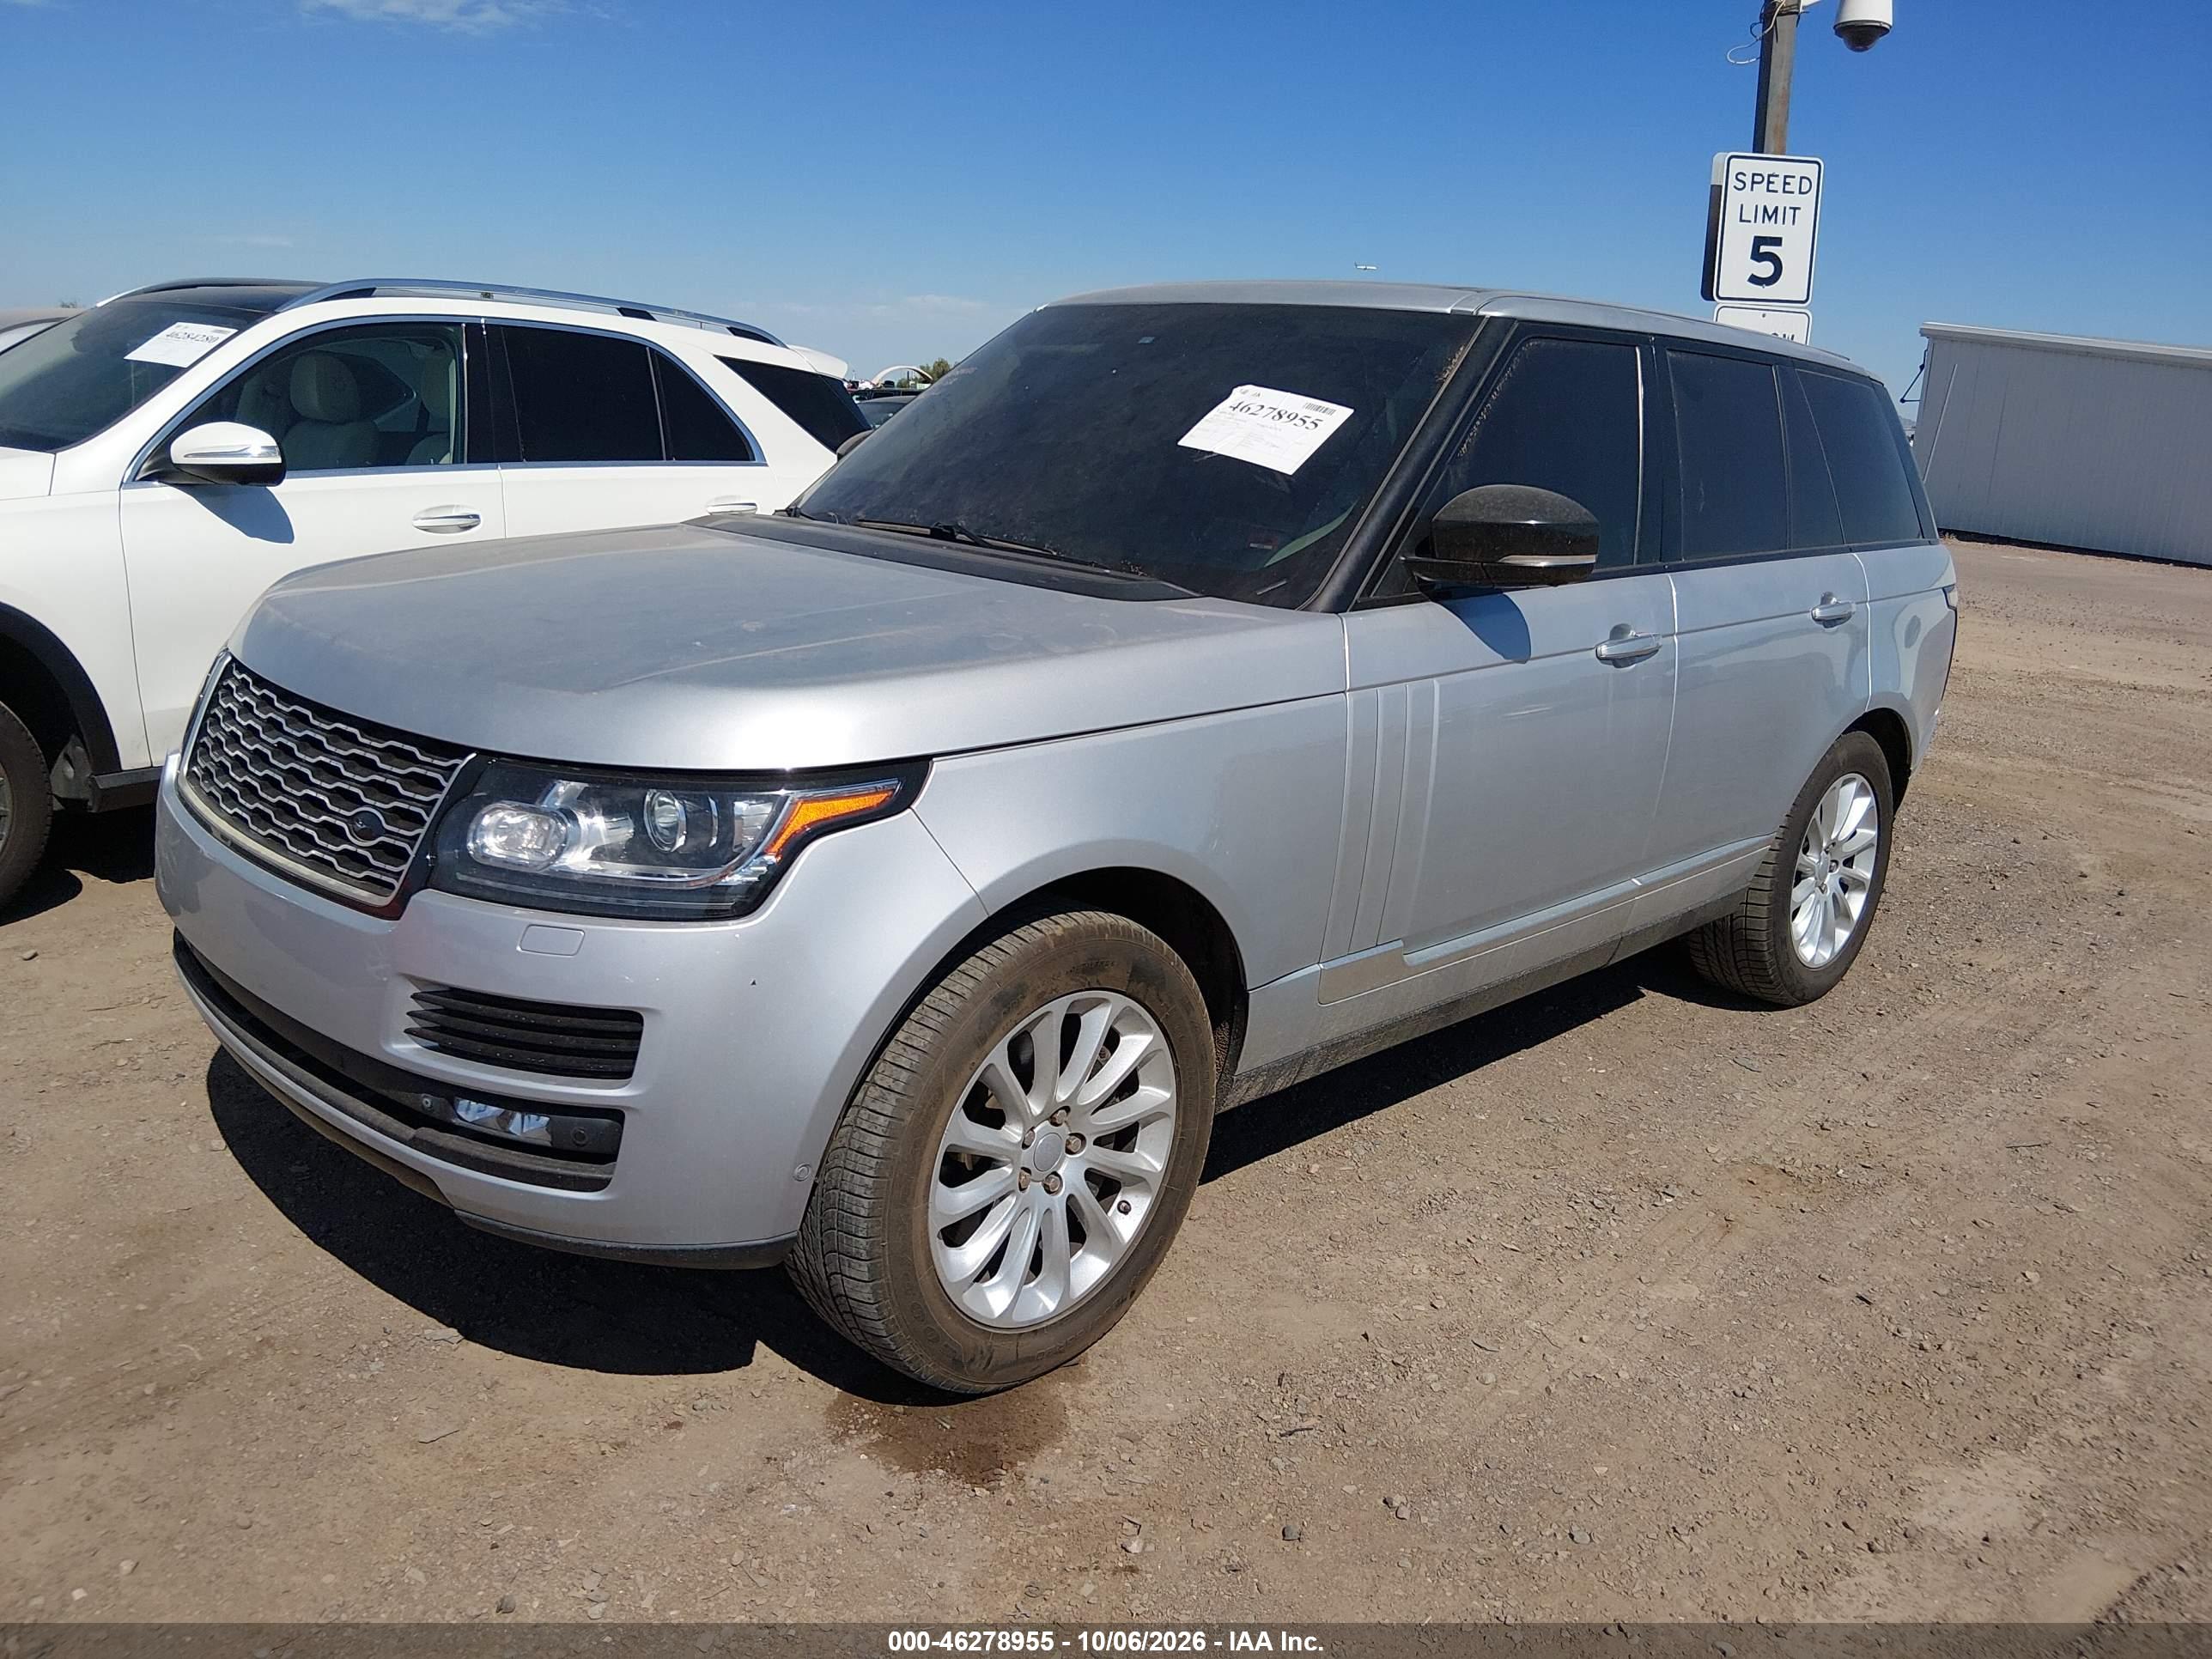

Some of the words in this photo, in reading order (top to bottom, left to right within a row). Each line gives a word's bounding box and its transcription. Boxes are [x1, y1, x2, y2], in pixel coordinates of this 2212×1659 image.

[1733, 172, 1813, 195] SPEED
[1738, 204, 1802, 226] LIMIT
[1747, 235, 1784, 287] 5
[1230, 400, 1324, 431] 46278955
